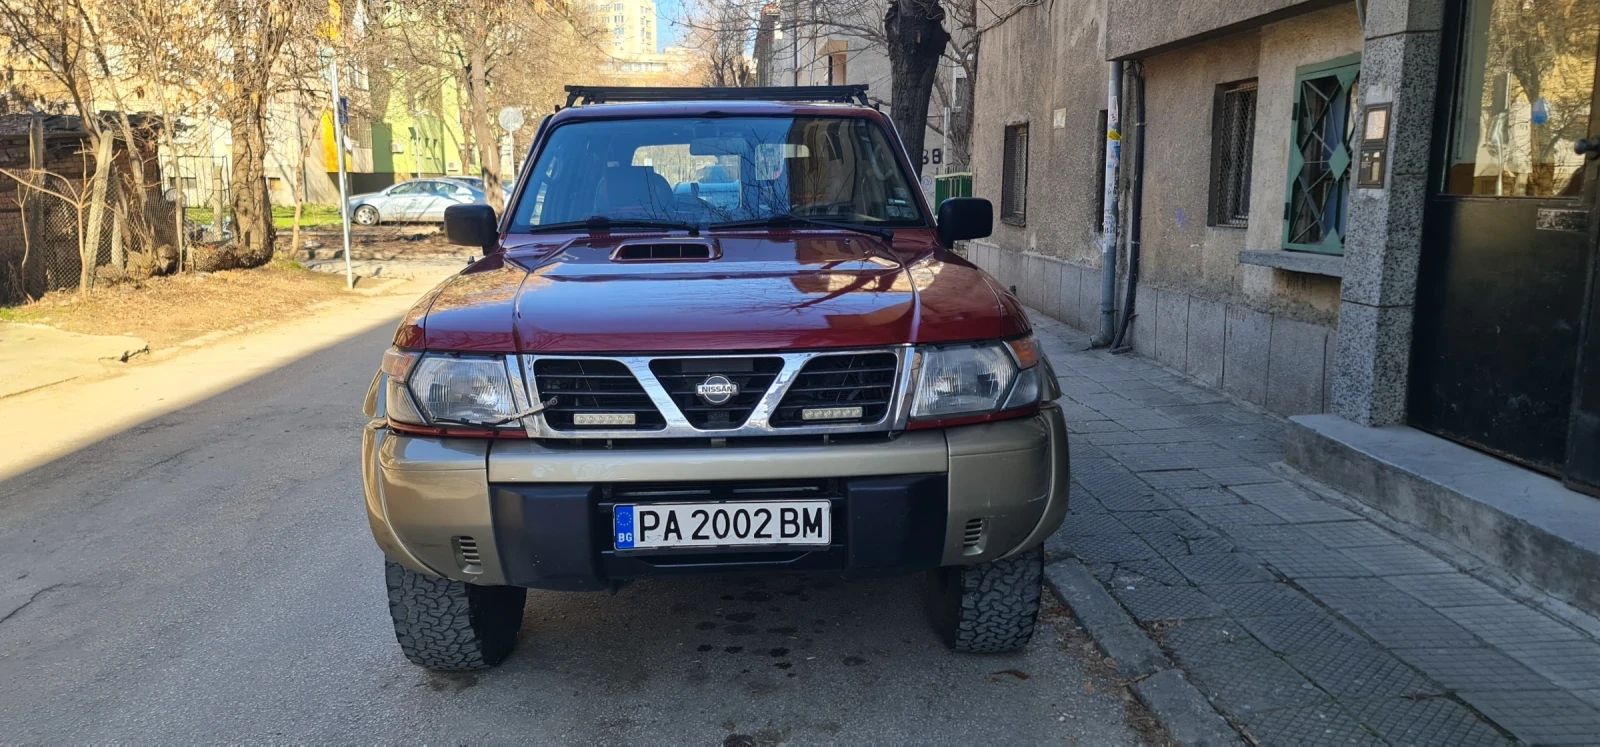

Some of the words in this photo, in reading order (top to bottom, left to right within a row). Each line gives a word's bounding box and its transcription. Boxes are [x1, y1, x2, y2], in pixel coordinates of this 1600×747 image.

[701, 385, 733, 393] NISSAN
[639, 510, 683, 542] PA
[690, 508, 772, 540] 2002
[779, 507, 823, 539] BM
[618, 532, 633, 543] BG
